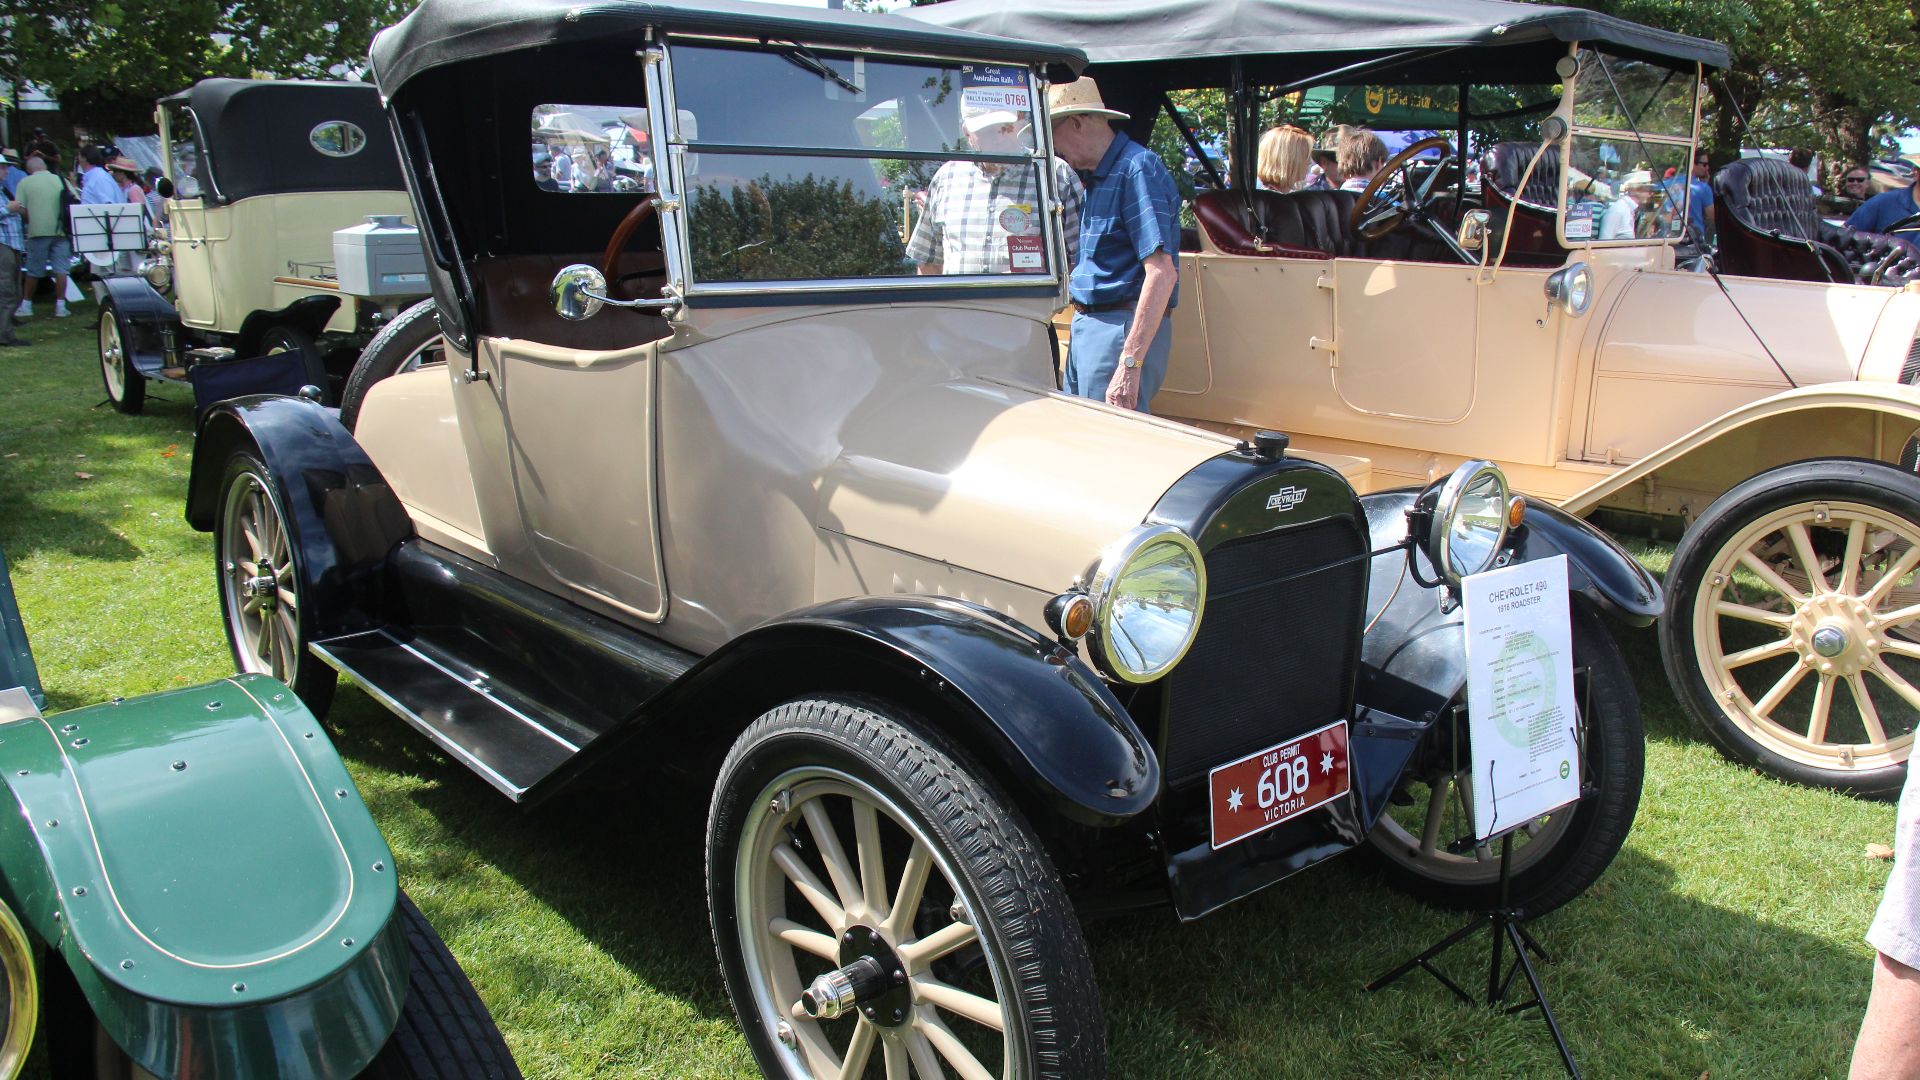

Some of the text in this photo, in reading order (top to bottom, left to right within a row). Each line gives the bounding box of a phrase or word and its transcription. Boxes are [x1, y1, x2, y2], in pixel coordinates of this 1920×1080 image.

[973, 74, 1000, 82] Australian
[985, 67, 1000, 75] Great
[1005, 94, 1026, 106] 0769
[1270, 492, 1303, 506] CHEVROLET
[1488, 580, 1548, 604] CHEVROLET 490
[1510, 595, 1541, 611] ROADSTER
[1262, 743, 1301, 768] CLUB PERMIT
[1257, 755, 1310, 809] 608
[1263, 796, 1306, 821] VICTORIA
